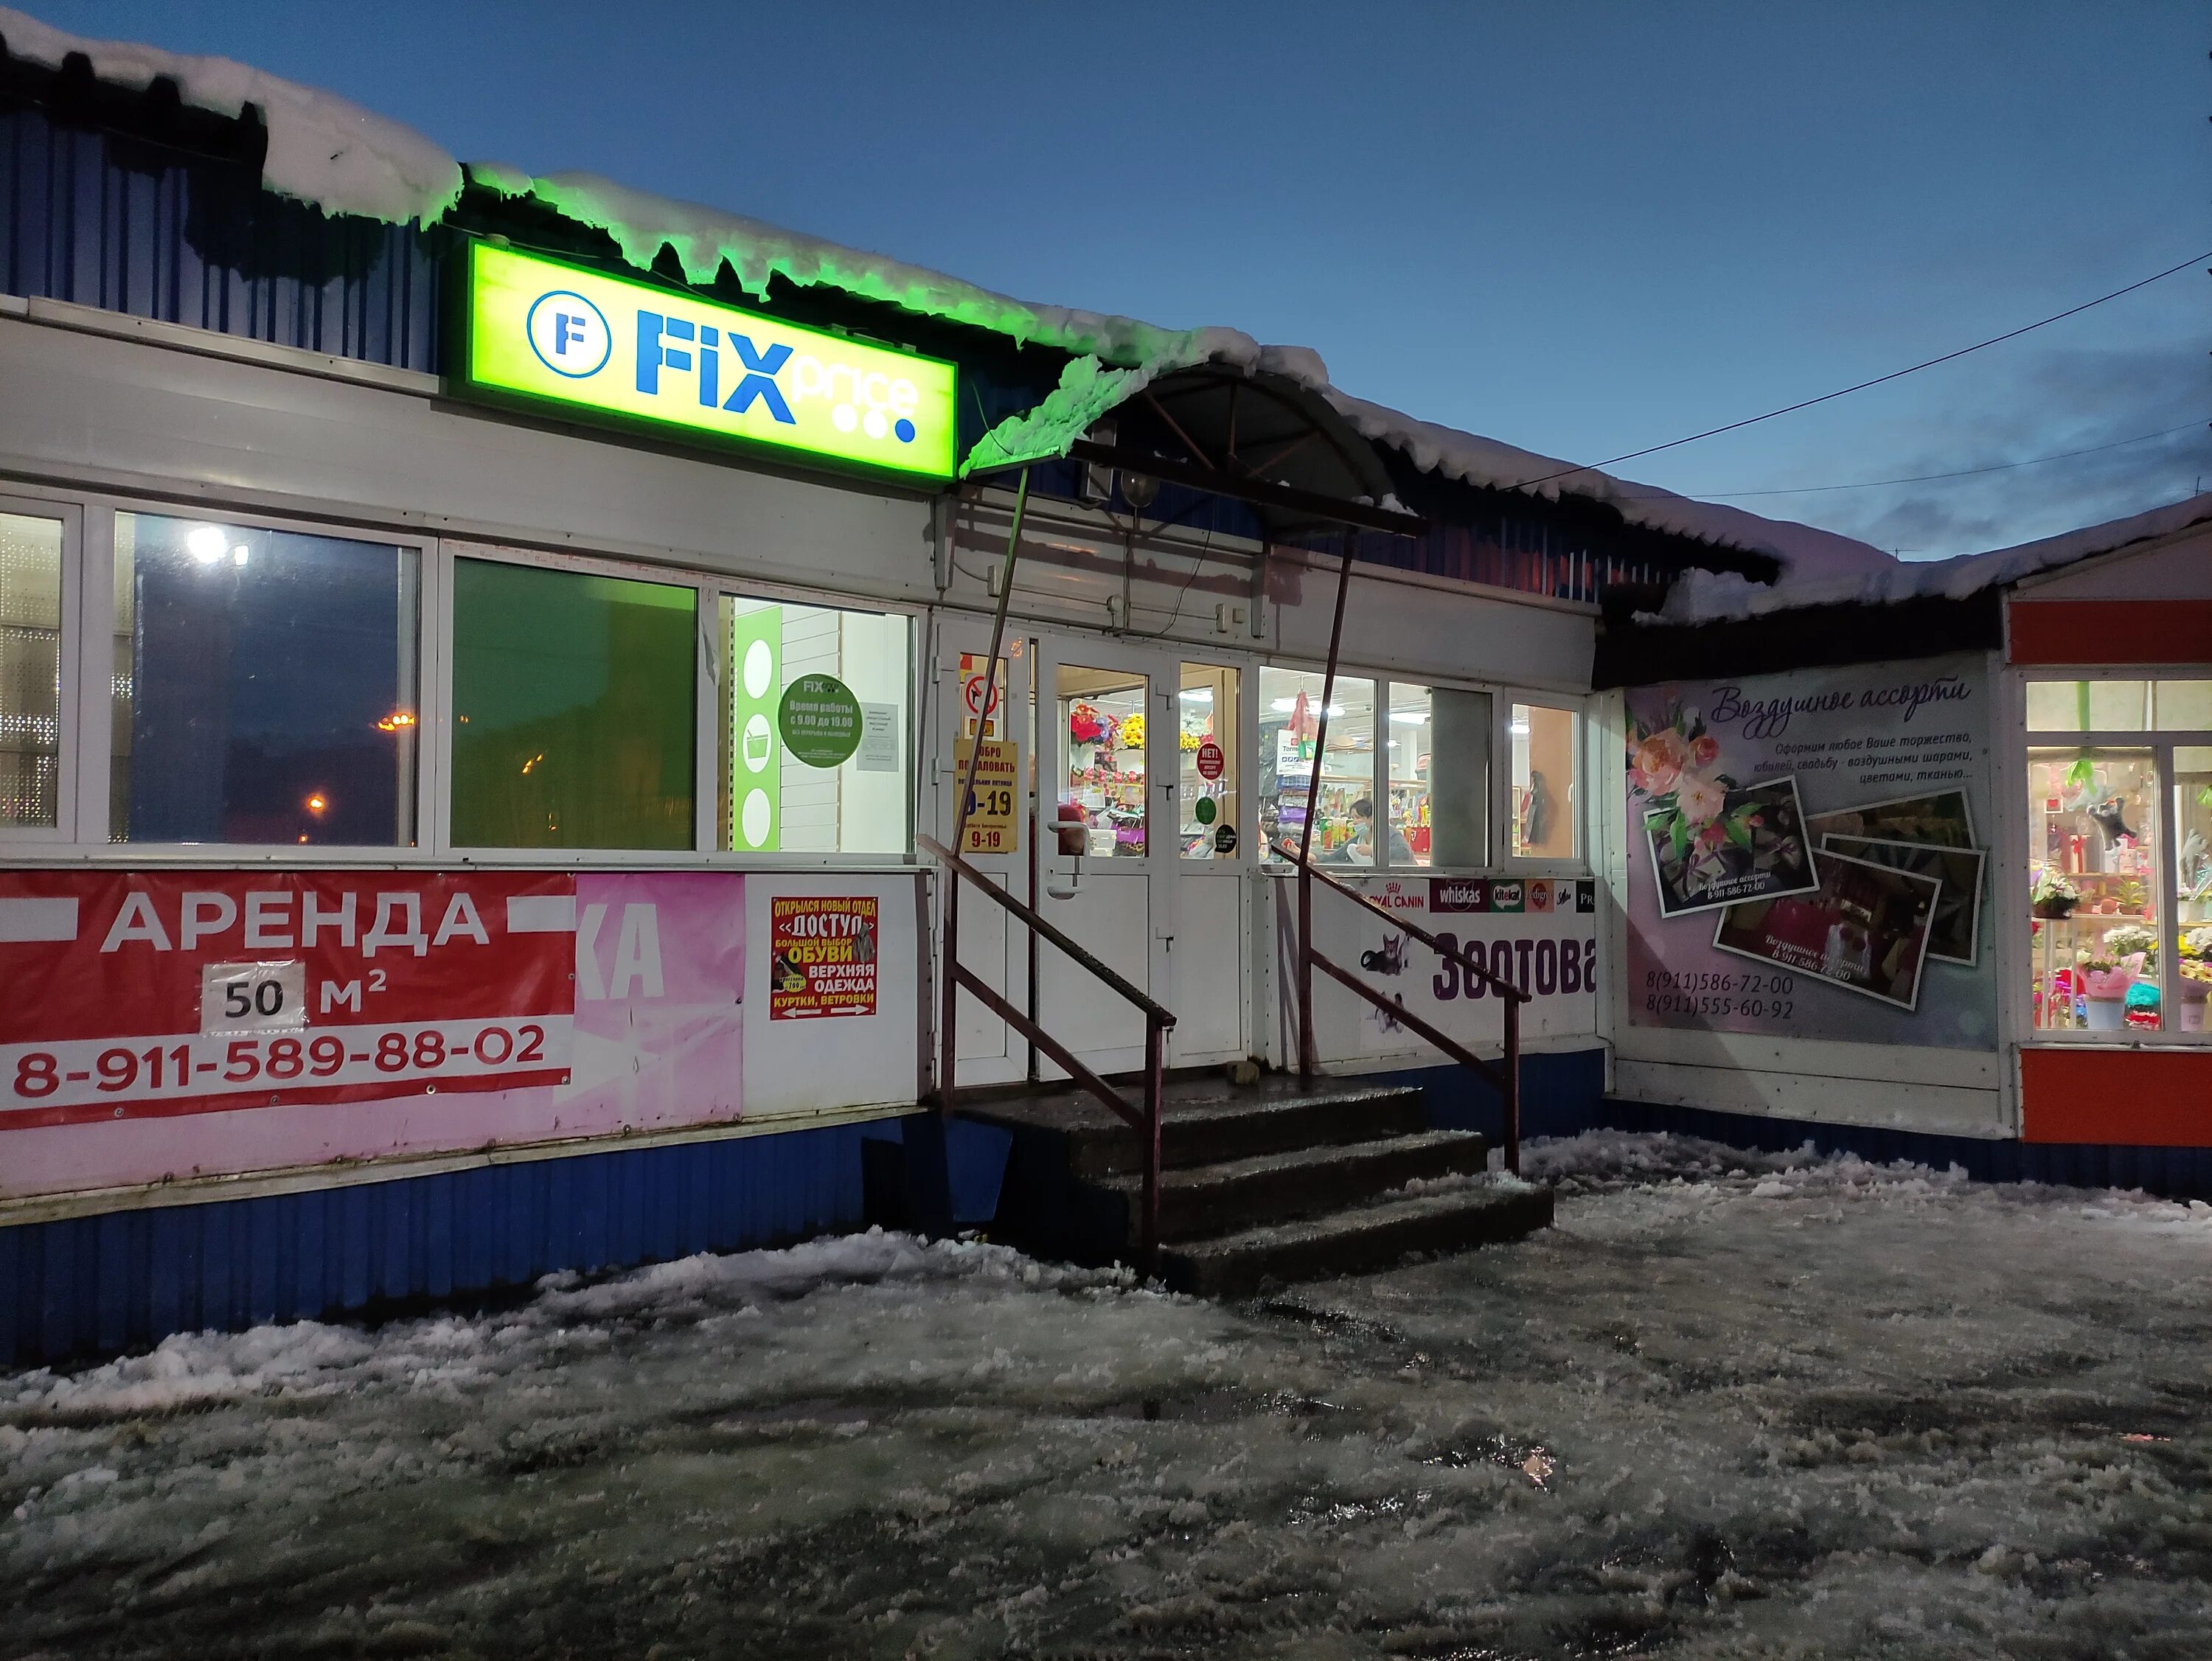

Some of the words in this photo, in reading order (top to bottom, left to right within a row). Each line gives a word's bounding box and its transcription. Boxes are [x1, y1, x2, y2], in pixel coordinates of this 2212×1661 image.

[793, 355, 919, 416] price
[790, 700, 818, 713] Время
[820, 703, 853, 714] работы
[1711, 686, 1854, 740] Воздушное
[1860, 675, 1972, 722] ассорти
[790, 716, 796, 725] с
[796, 714, 816, 726] 9.00
[818, 717, 829, 728] до
[830, 717, 852, 728] 19.00
[1775, 740, 1826, 756] Оформим
[1829, 739, 1863, 752] любое
[1865, 737, 1896, 749] Ваше
[1899, 733, 1972, 748] торжество,
[1202, 748, 1218, 759] НЕТ!
[1754, 760, 1794, 773] юбилей,
[1797, 757, 1838, 771] свадьбу
[1848, 754, 1919, 767] воздушными
[1923, 751, 1972, 765] шарами,
[959, 759, 1015, 773] ПОАЛОВАТЬ
[1860, 772, 1913, 785] цветами,
[971, 831, 1001, 847] 9-19
[1394, 896, 1425, 908] CANIN
[1440, 886, 1481, 904] whiskas
[1495, 888, 1520, 901] kitekat
[1580, 893, 1595, 905] PR
[774, 899, 820, 918] ОТКРЫЛСЯ
[821, 897, 851, 913] НОВЫЙ
[852, 900, 876, 917] ОТДЕЛ
[100, 891, 490, 958] АРЕНДА
[775, 937, 819, 948] БОЛЬШОЙ
[821, 938, 852, 947] ВЫБОР
[787, 946, 853, 964] ОБУВИ
[1820, 952, 1865, 973] аорти
[809, 964, 874, 979] ВЕРХНЯЯ
[814, 978, 874, 995] ОДЕЖДА
[1646, 971, 1794, 995] 8(911)586-72-00
[223, 980, 285, 1019] 50
[773, 996, 818, 1008] КУРТКИ,
[821, 993, 874, 1006] ВЕТРОВКИ
[1646, 993, 1794, 1020] 8(911)555-60-92
[13, 1024, 546, 1099] 8-911-589-88-02
